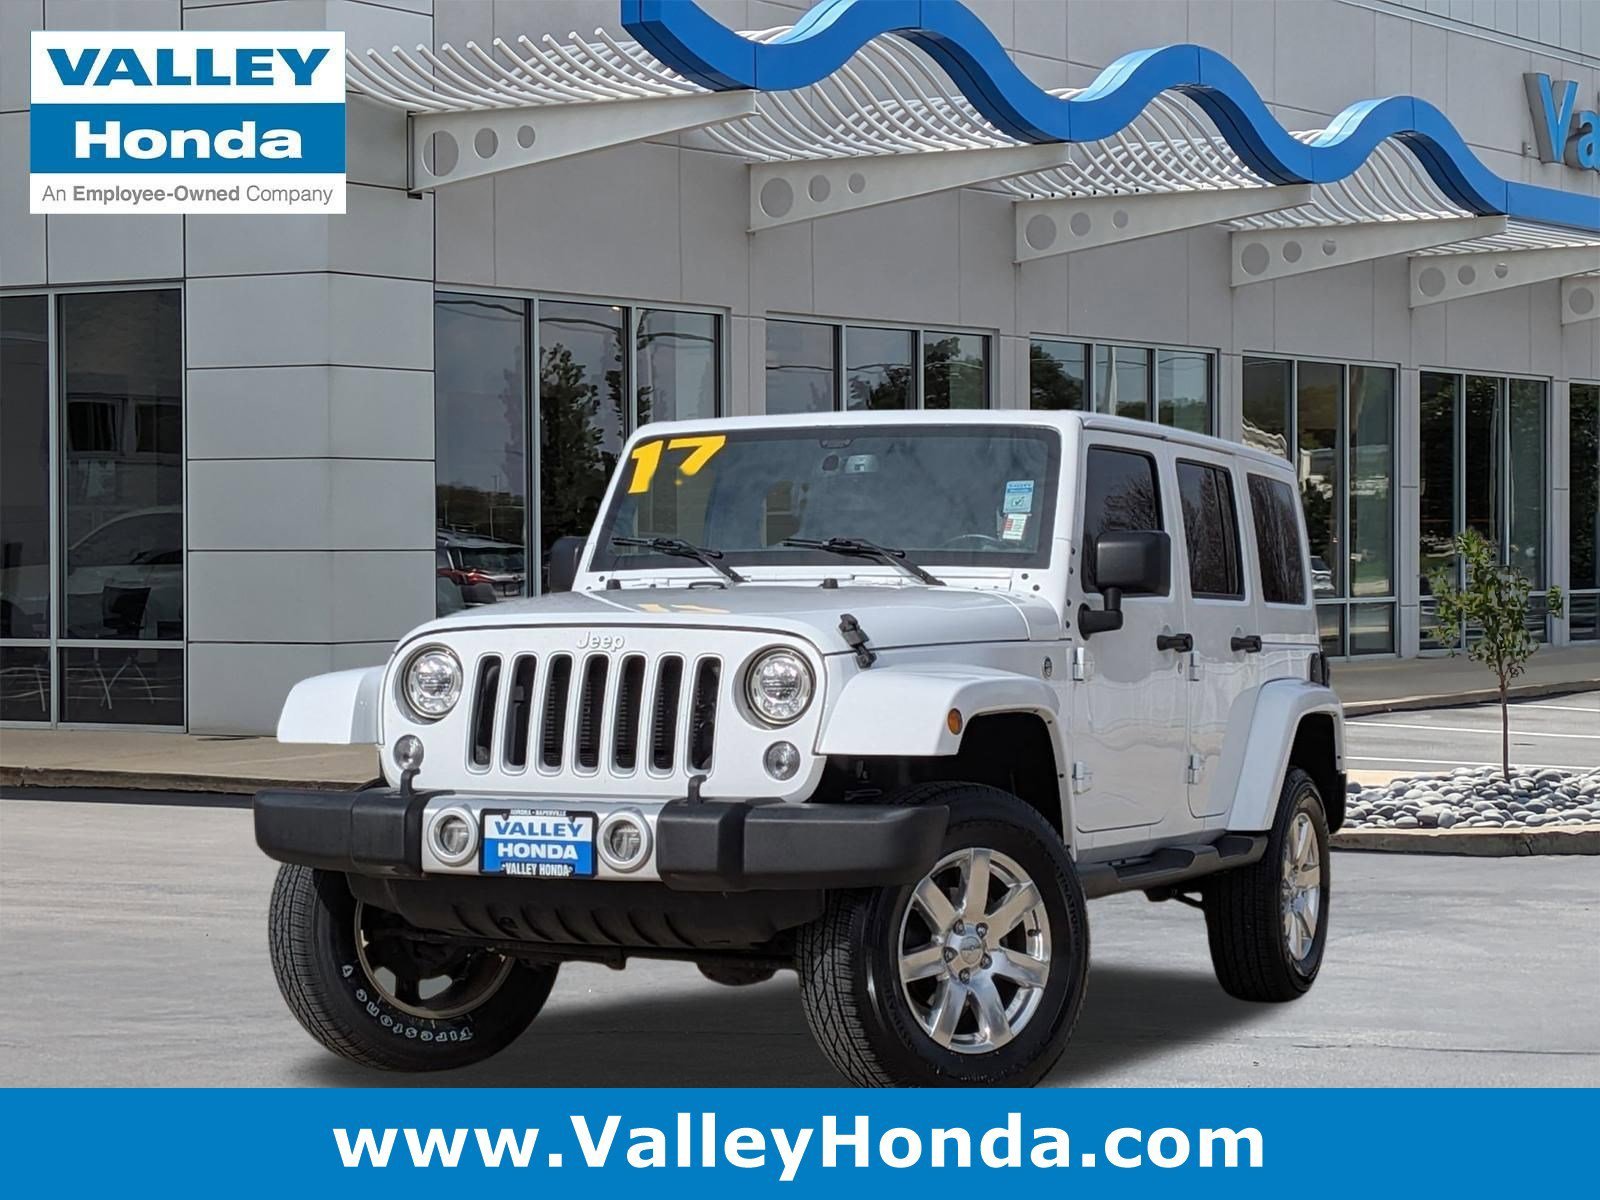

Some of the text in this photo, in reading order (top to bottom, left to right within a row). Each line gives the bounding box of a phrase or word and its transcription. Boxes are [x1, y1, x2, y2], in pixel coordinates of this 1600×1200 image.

[627, 434, 727, 494] 17
[576, 631, 625, 651] Jeep
[494, 821, 583, 837] VALLEY
[497, 842, 579, 860] HONDA
[505, 862, 570, 877] VALLEY HONDA
